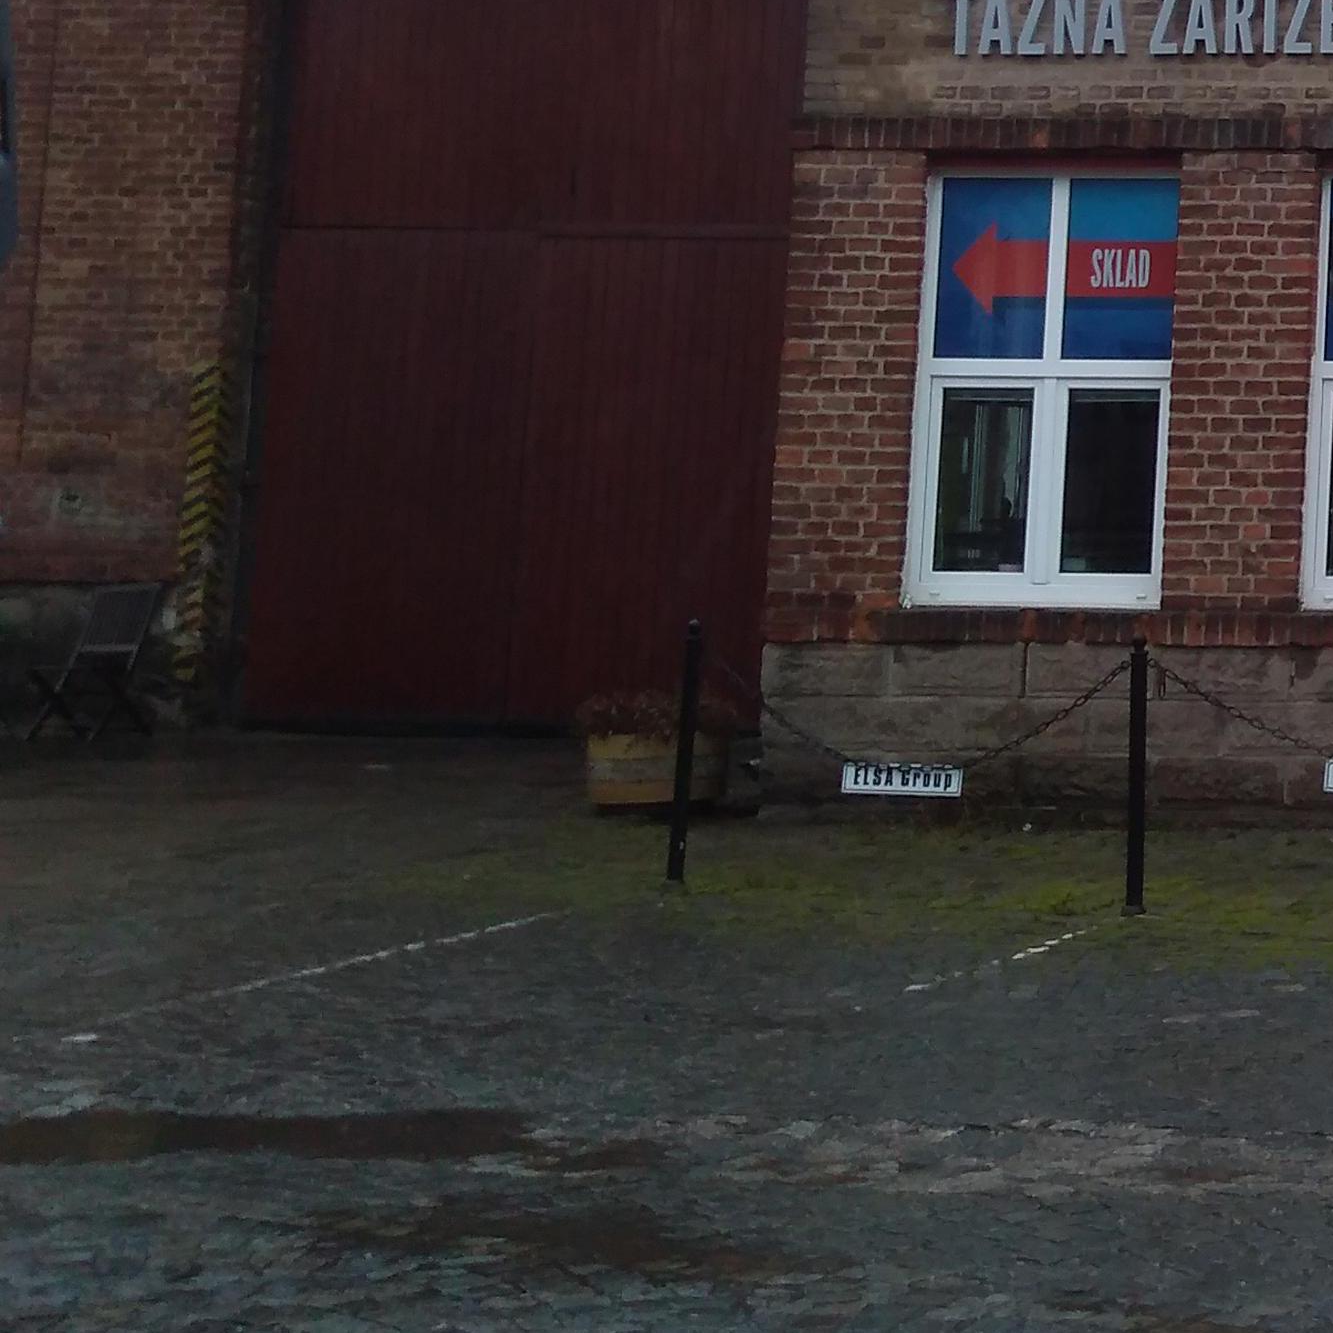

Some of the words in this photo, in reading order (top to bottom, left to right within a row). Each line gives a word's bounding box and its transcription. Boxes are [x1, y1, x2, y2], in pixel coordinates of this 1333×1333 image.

[1090, 248, 1150, 289] SKLAD
[853, 766, 893, 786] ELSA
[901, 768, 952, 791] Group
